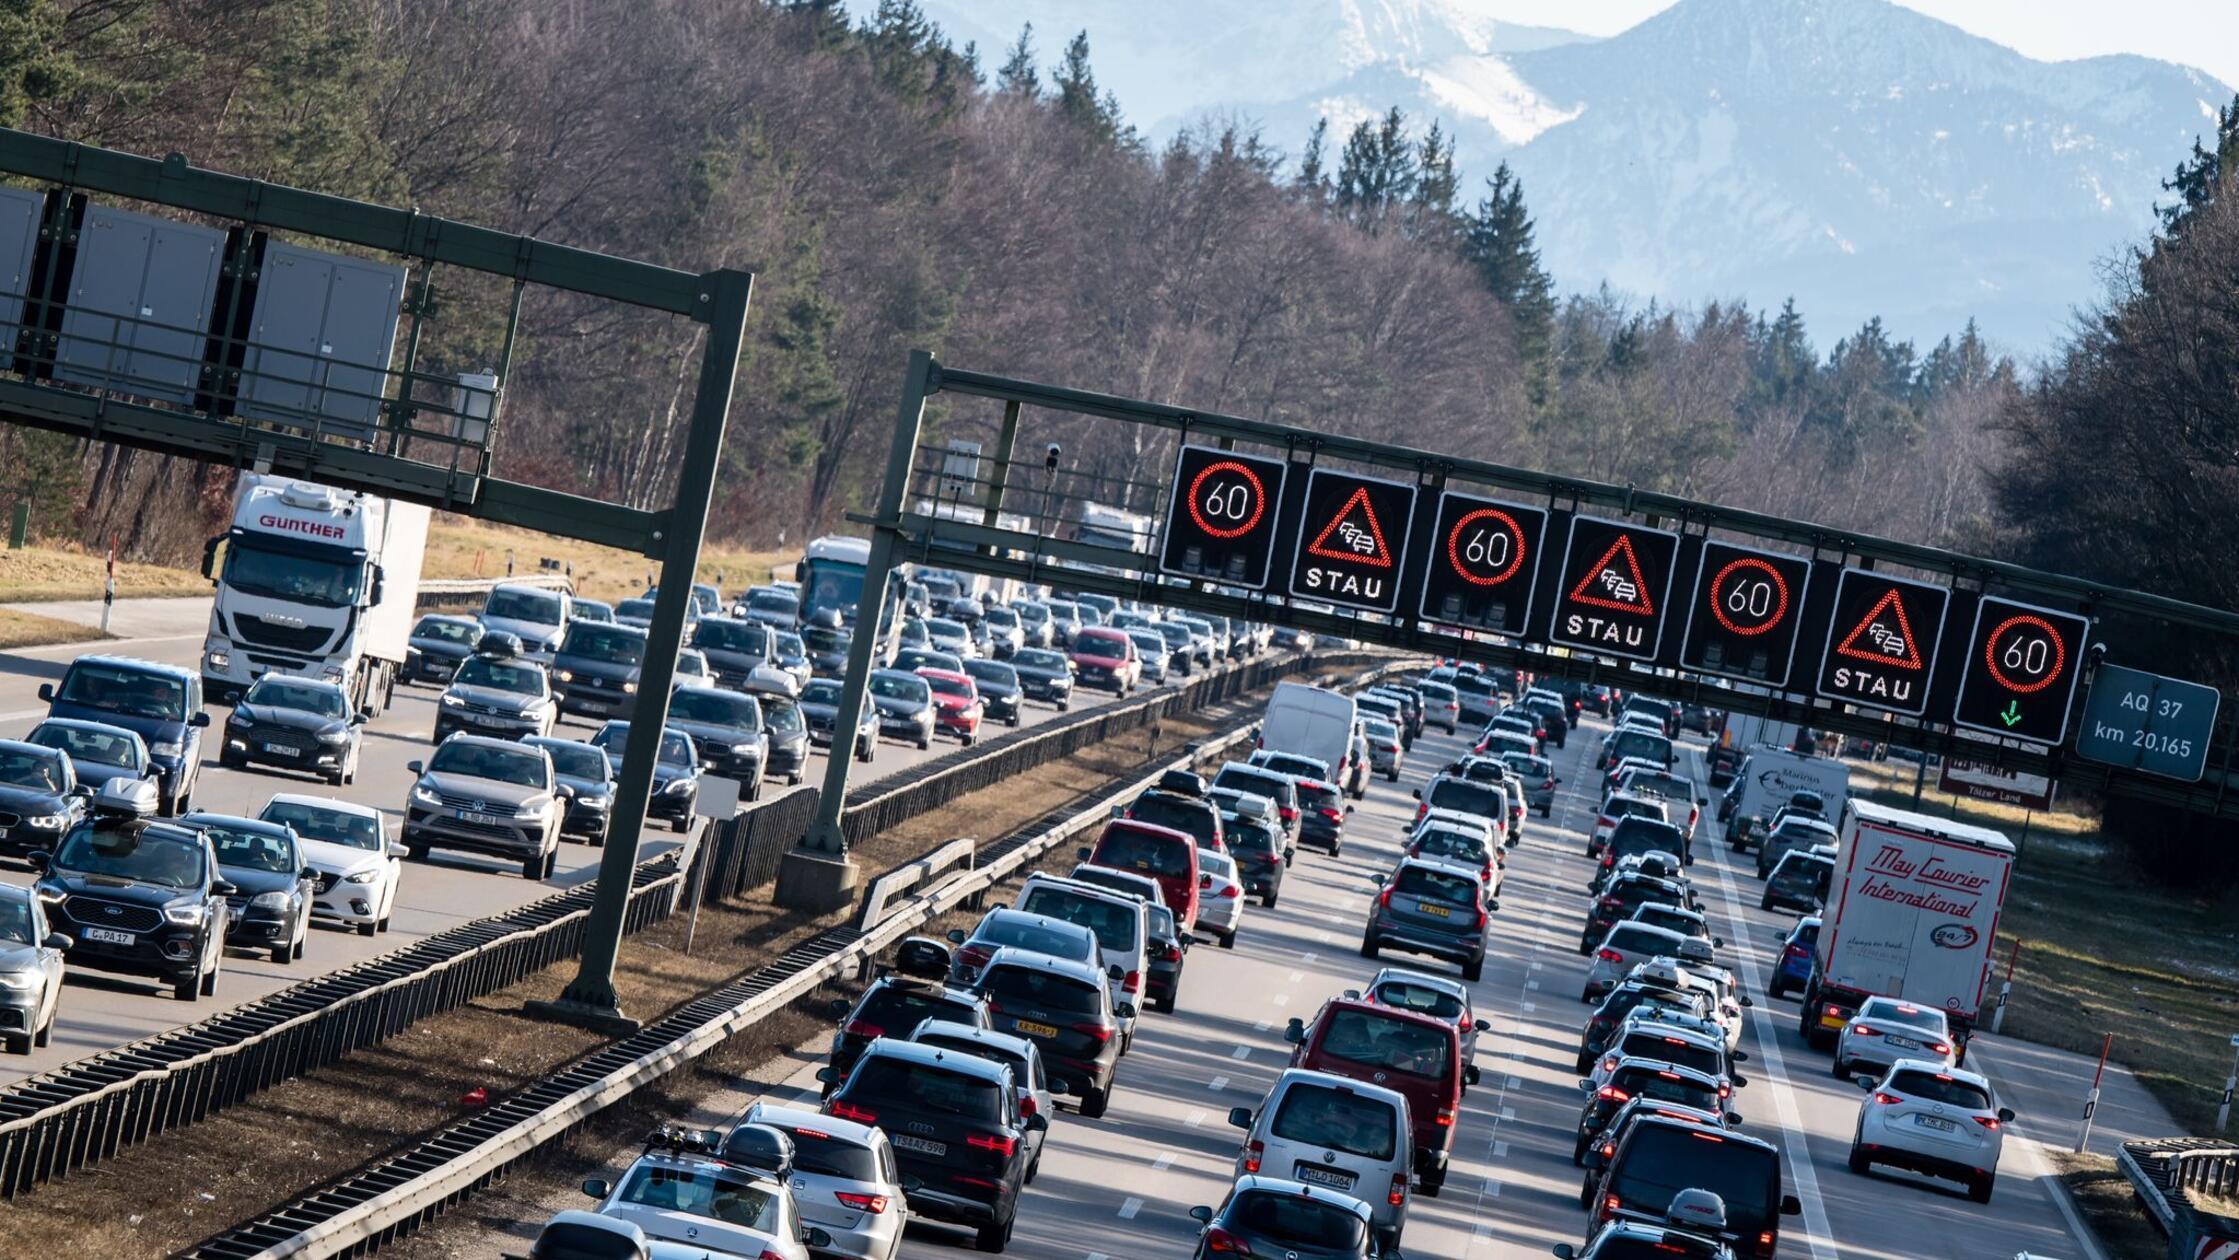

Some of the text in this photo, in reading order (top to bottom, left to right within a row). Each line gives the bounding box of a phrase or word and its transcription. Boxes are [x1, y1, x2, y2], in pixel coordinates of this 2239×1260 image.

[1206, 482, 1248, 520] 60
[1465, 528, 1508, 568] 60
[1306, 567, 1382, 598] STAU
[1728, 578, 1771, 617] 60
[1566, 614, 1643, 646] STAU
[2004, 636, 2047, 674] 60
[1834, 668, 1911, 700] STAU
[2120, 691, 2183, 719] AQ 37
[2095, 720, 2192, 757] km 20.165
[2000, 791, 2021, 803] Land
[1866, 845, 1990, 890] May Courier
[1858, 875, 1978, 918] International
[1936, 930, 1972, 942] 24/7
